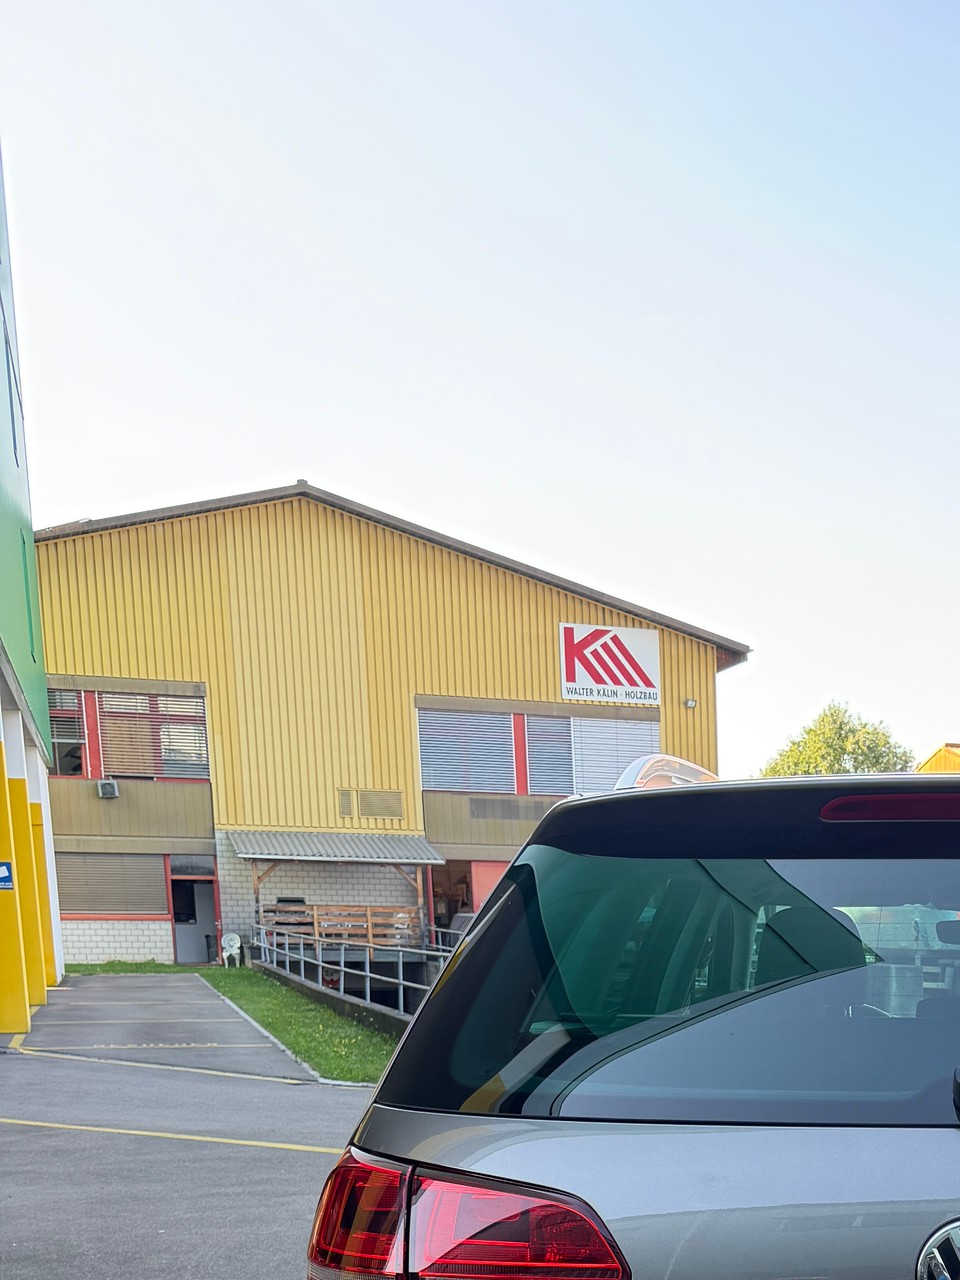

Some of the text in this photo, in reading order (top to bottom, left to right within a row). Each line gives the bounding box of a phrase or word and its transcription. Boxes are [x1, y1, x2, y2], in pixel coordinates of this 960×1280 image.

[566, 686, 658, 701] WALTER KÄLIN HOLZBAU
